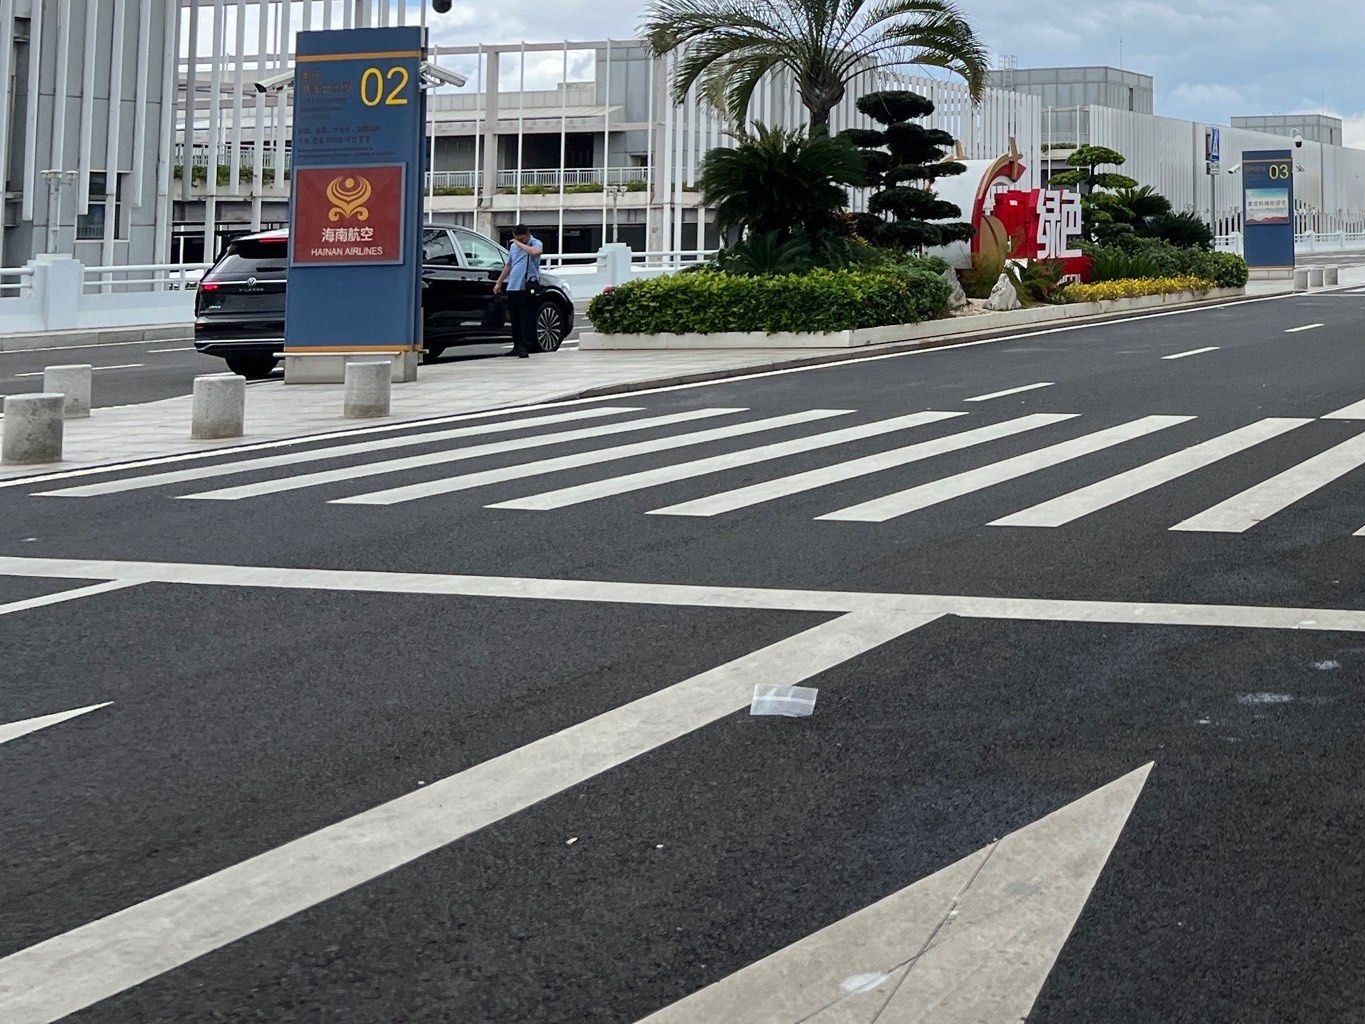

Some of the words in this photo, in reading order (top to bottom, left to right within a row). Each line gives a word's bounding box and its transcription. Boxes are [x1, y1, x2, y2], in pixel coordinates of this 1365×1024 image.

[360, 66, 409, 107] 02
[1269, 164, 1289, 180] 03
[322, 226, 374, 243] 海南航空
[311, 247, 342, 256] HAINAN
[345, 246, 383, 256] AIRLINES
